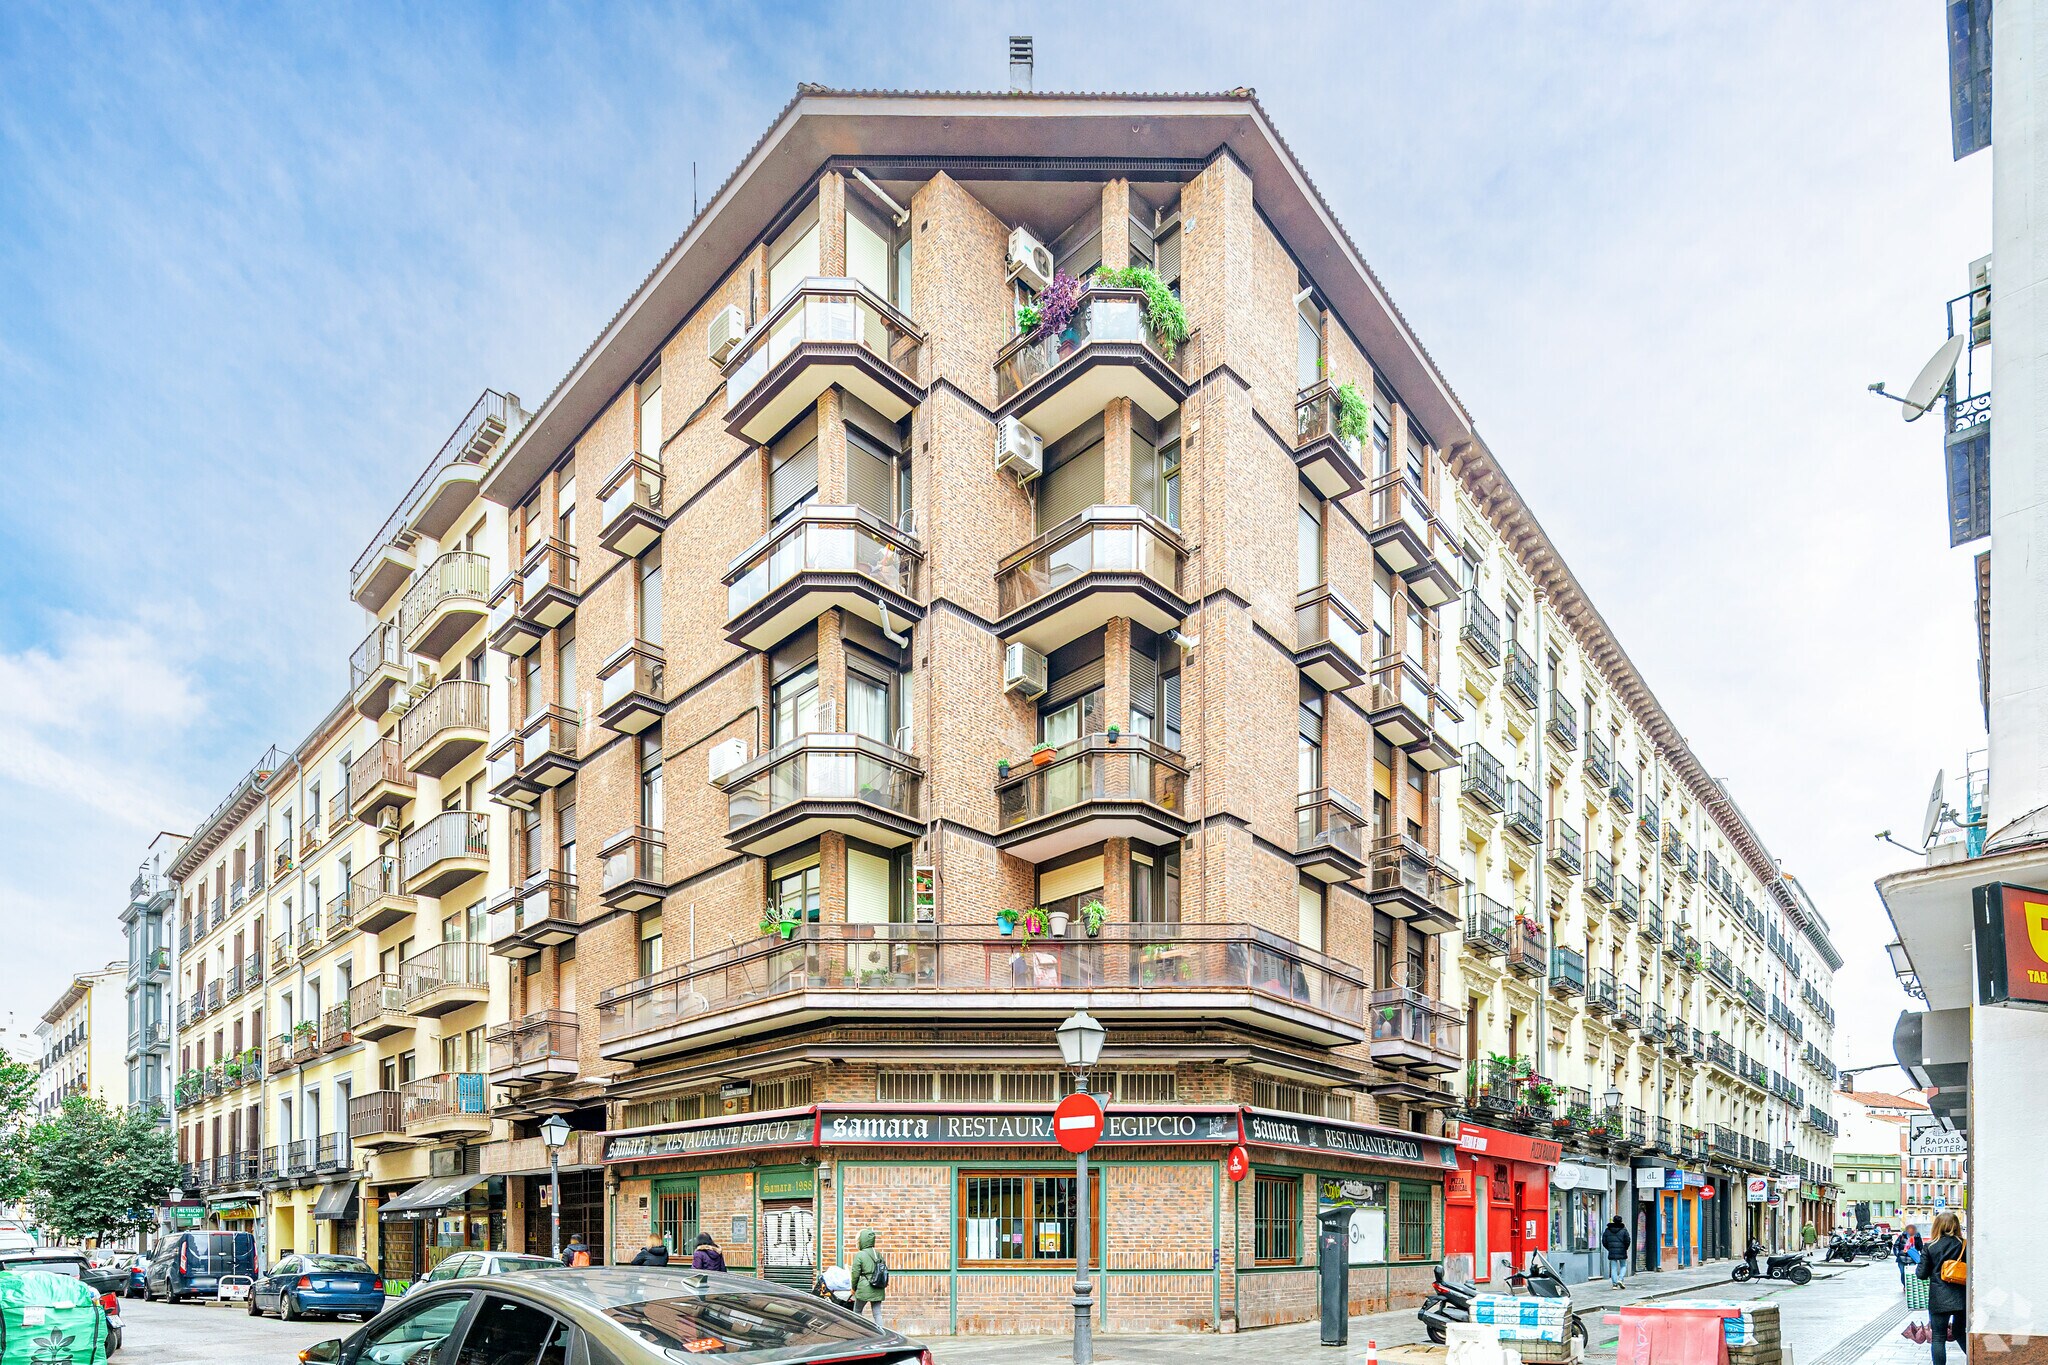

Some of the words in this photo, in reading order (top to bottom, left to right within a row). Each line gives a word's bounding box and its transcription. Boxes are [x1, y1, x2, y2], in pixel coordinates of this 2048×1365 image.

[664, 1126, 740, 1151] RESTAURANTE
[740, 1120, 790, 1144] EGIPCIO
[832, 1115, 929, 1139] samara
[947, 1116, 1104, 1138] RESTAURA
[1109, 1115, 1196, 1138] EGIPCIO
[1252, 1116, 1300, 1144] samara
[606, 1138, 647, 1158] samara
[1324, 1129, 1388, 1155] RESTAURANTE
[1387, 1136, 1418, 1159] EGIPCIO
[1920, 1145, 1965, 1154] KNITTER
[1925, 1136, 1960, 1145] BADASS
[763, 1181, 792, 1194] Samara
[795, 1180, 813, 1192] 1988
[1448, 1184, 1468, 1192] RADICAL
[1450, 1177, 1465, 1185] PIZZA
